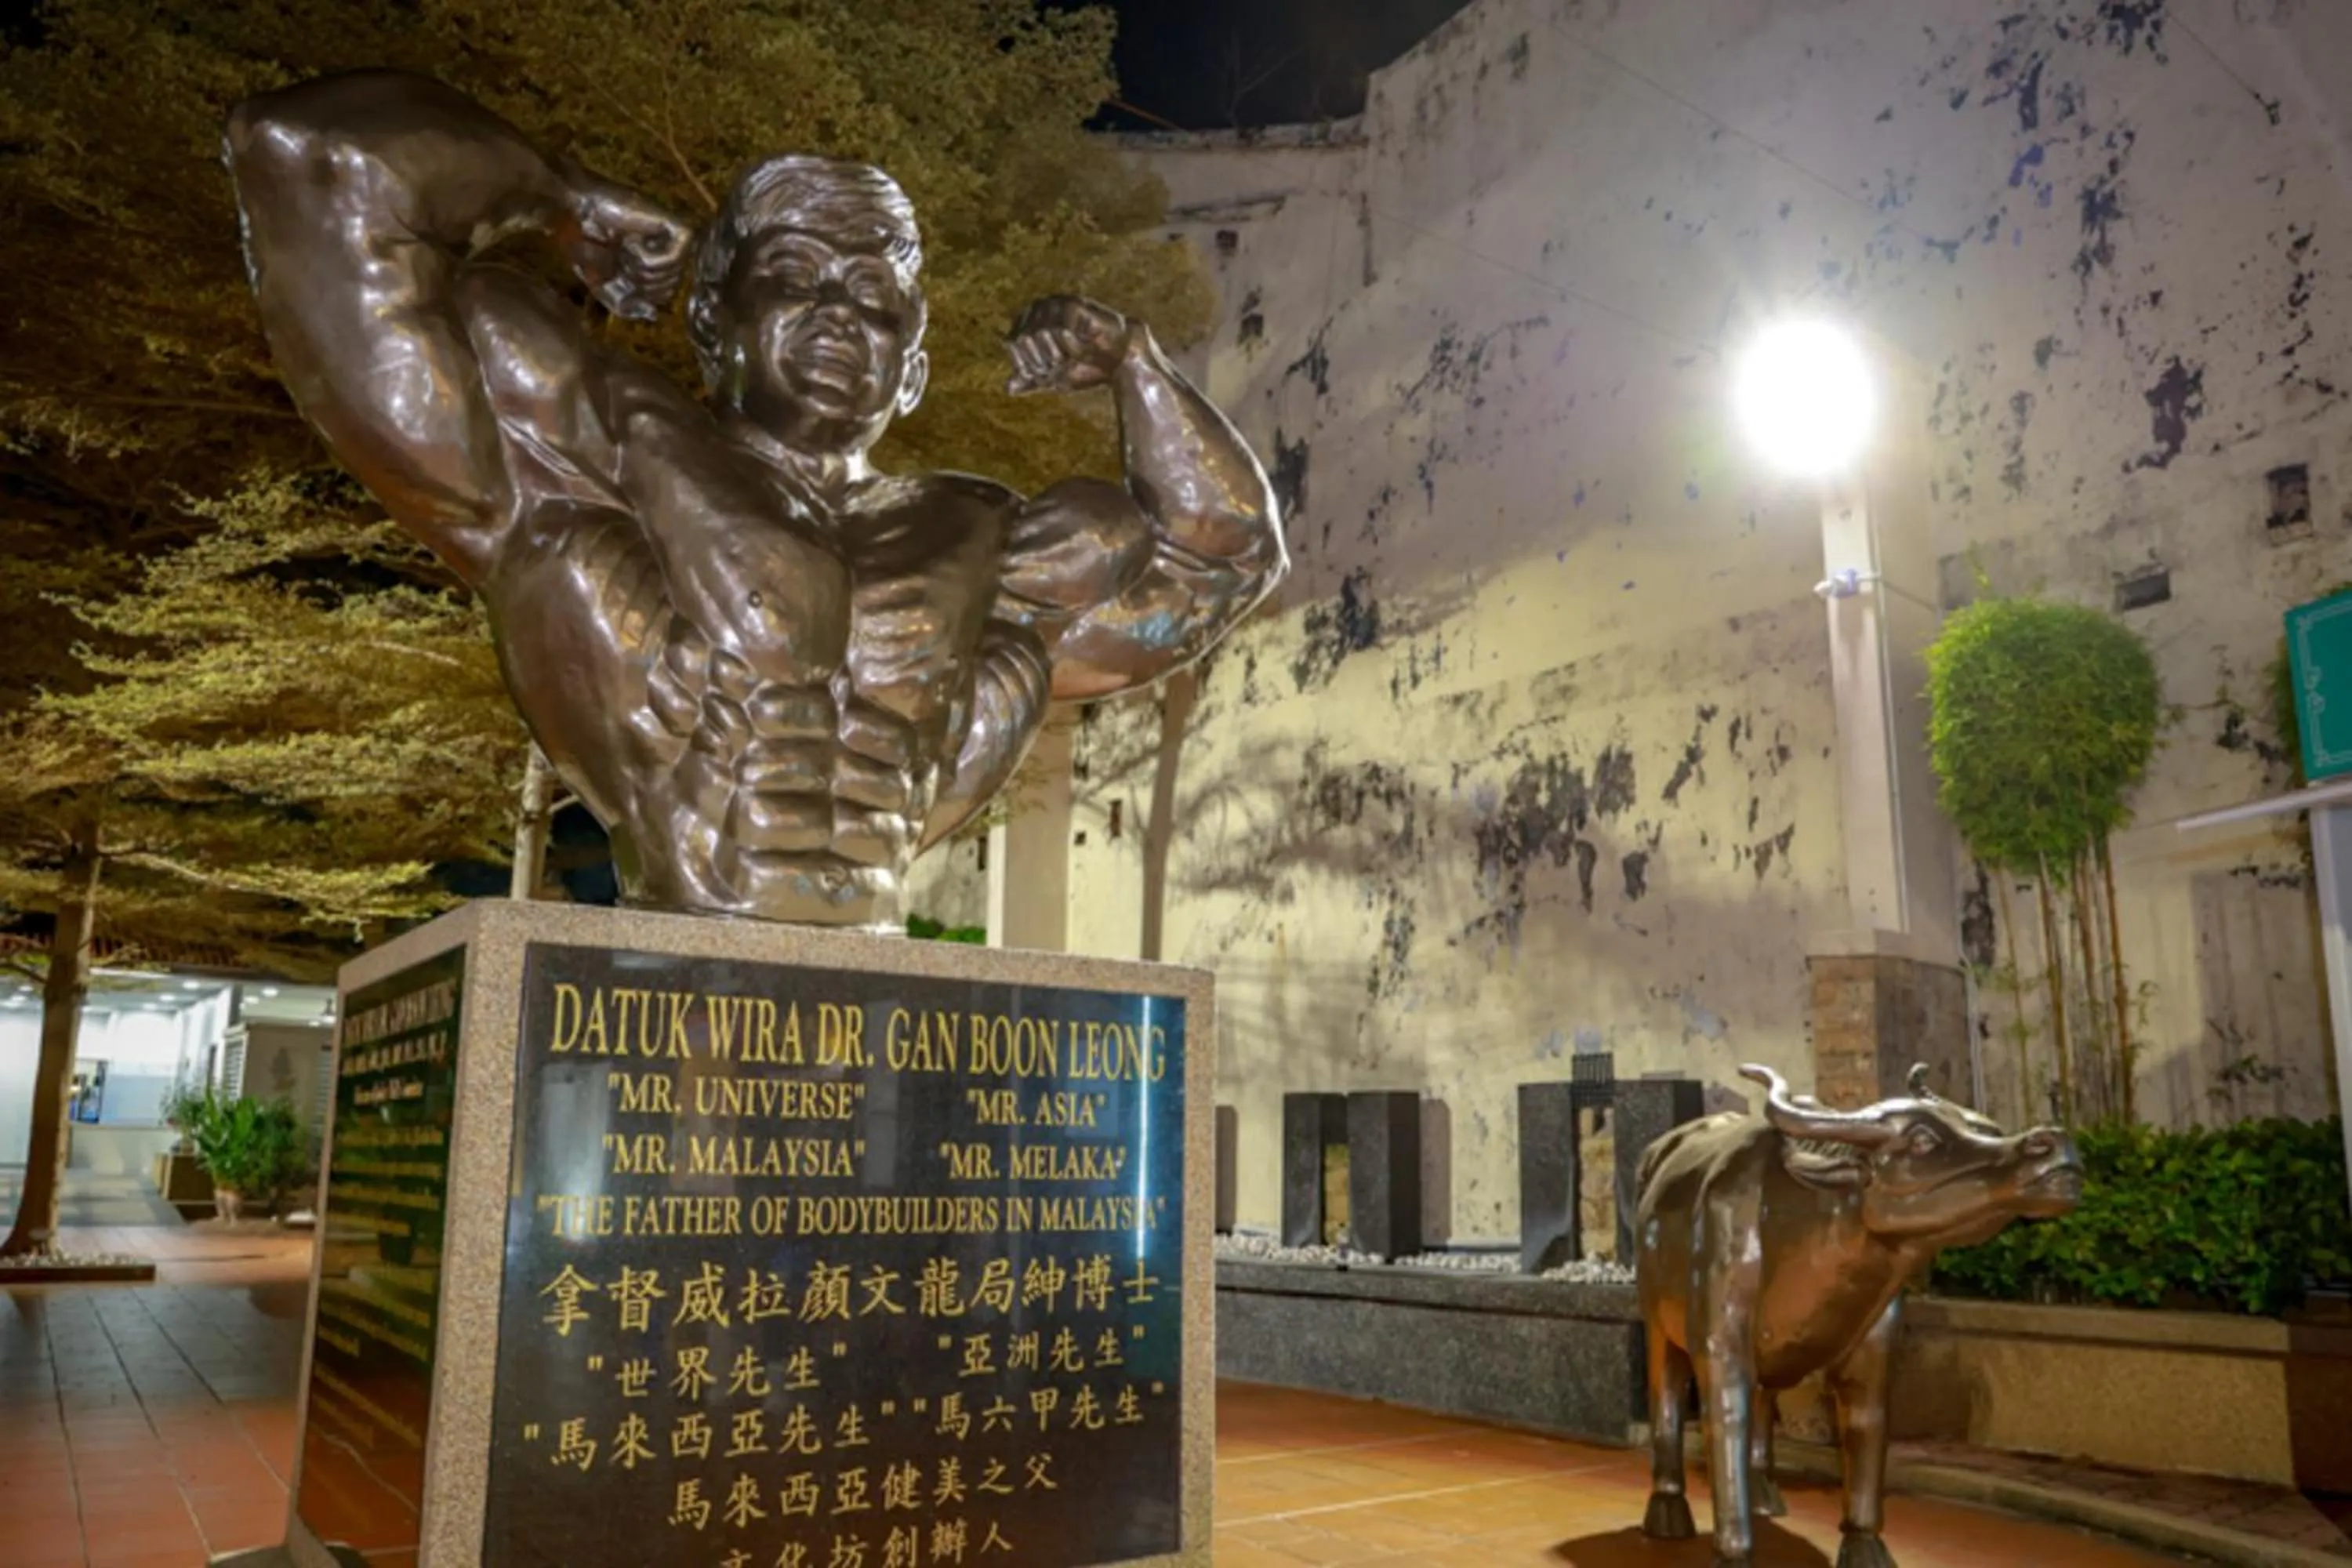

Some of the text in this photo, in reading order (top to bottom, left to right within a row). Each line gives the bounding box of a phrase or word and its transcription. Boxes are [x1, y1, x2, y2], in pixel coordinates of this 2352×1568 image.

[550, 982, 1167, 1083] DATUK WIRA DR. GAN BOON LEONG
[608, 1072, 866, 1121] "MR. UNIVERSE"
[966, 1087, 1106, 1127] "MR. ASIA"
[601, 1132, 866, 1178] "MR. MALAYSIA"
[939, 1142, 1000, 1181] "MR.
[537, 1193, 615, 1237] "THE
[624, 1195, 743, 1237] FATHER
[750, 1196, 790, 1236] OF
[797, 1195, 999, 1236] BODYBUILDERS
[1005, 1196, 1034, 1232] IN
[666, 1451, 1058, 1531] 馬來西亞健美之父
